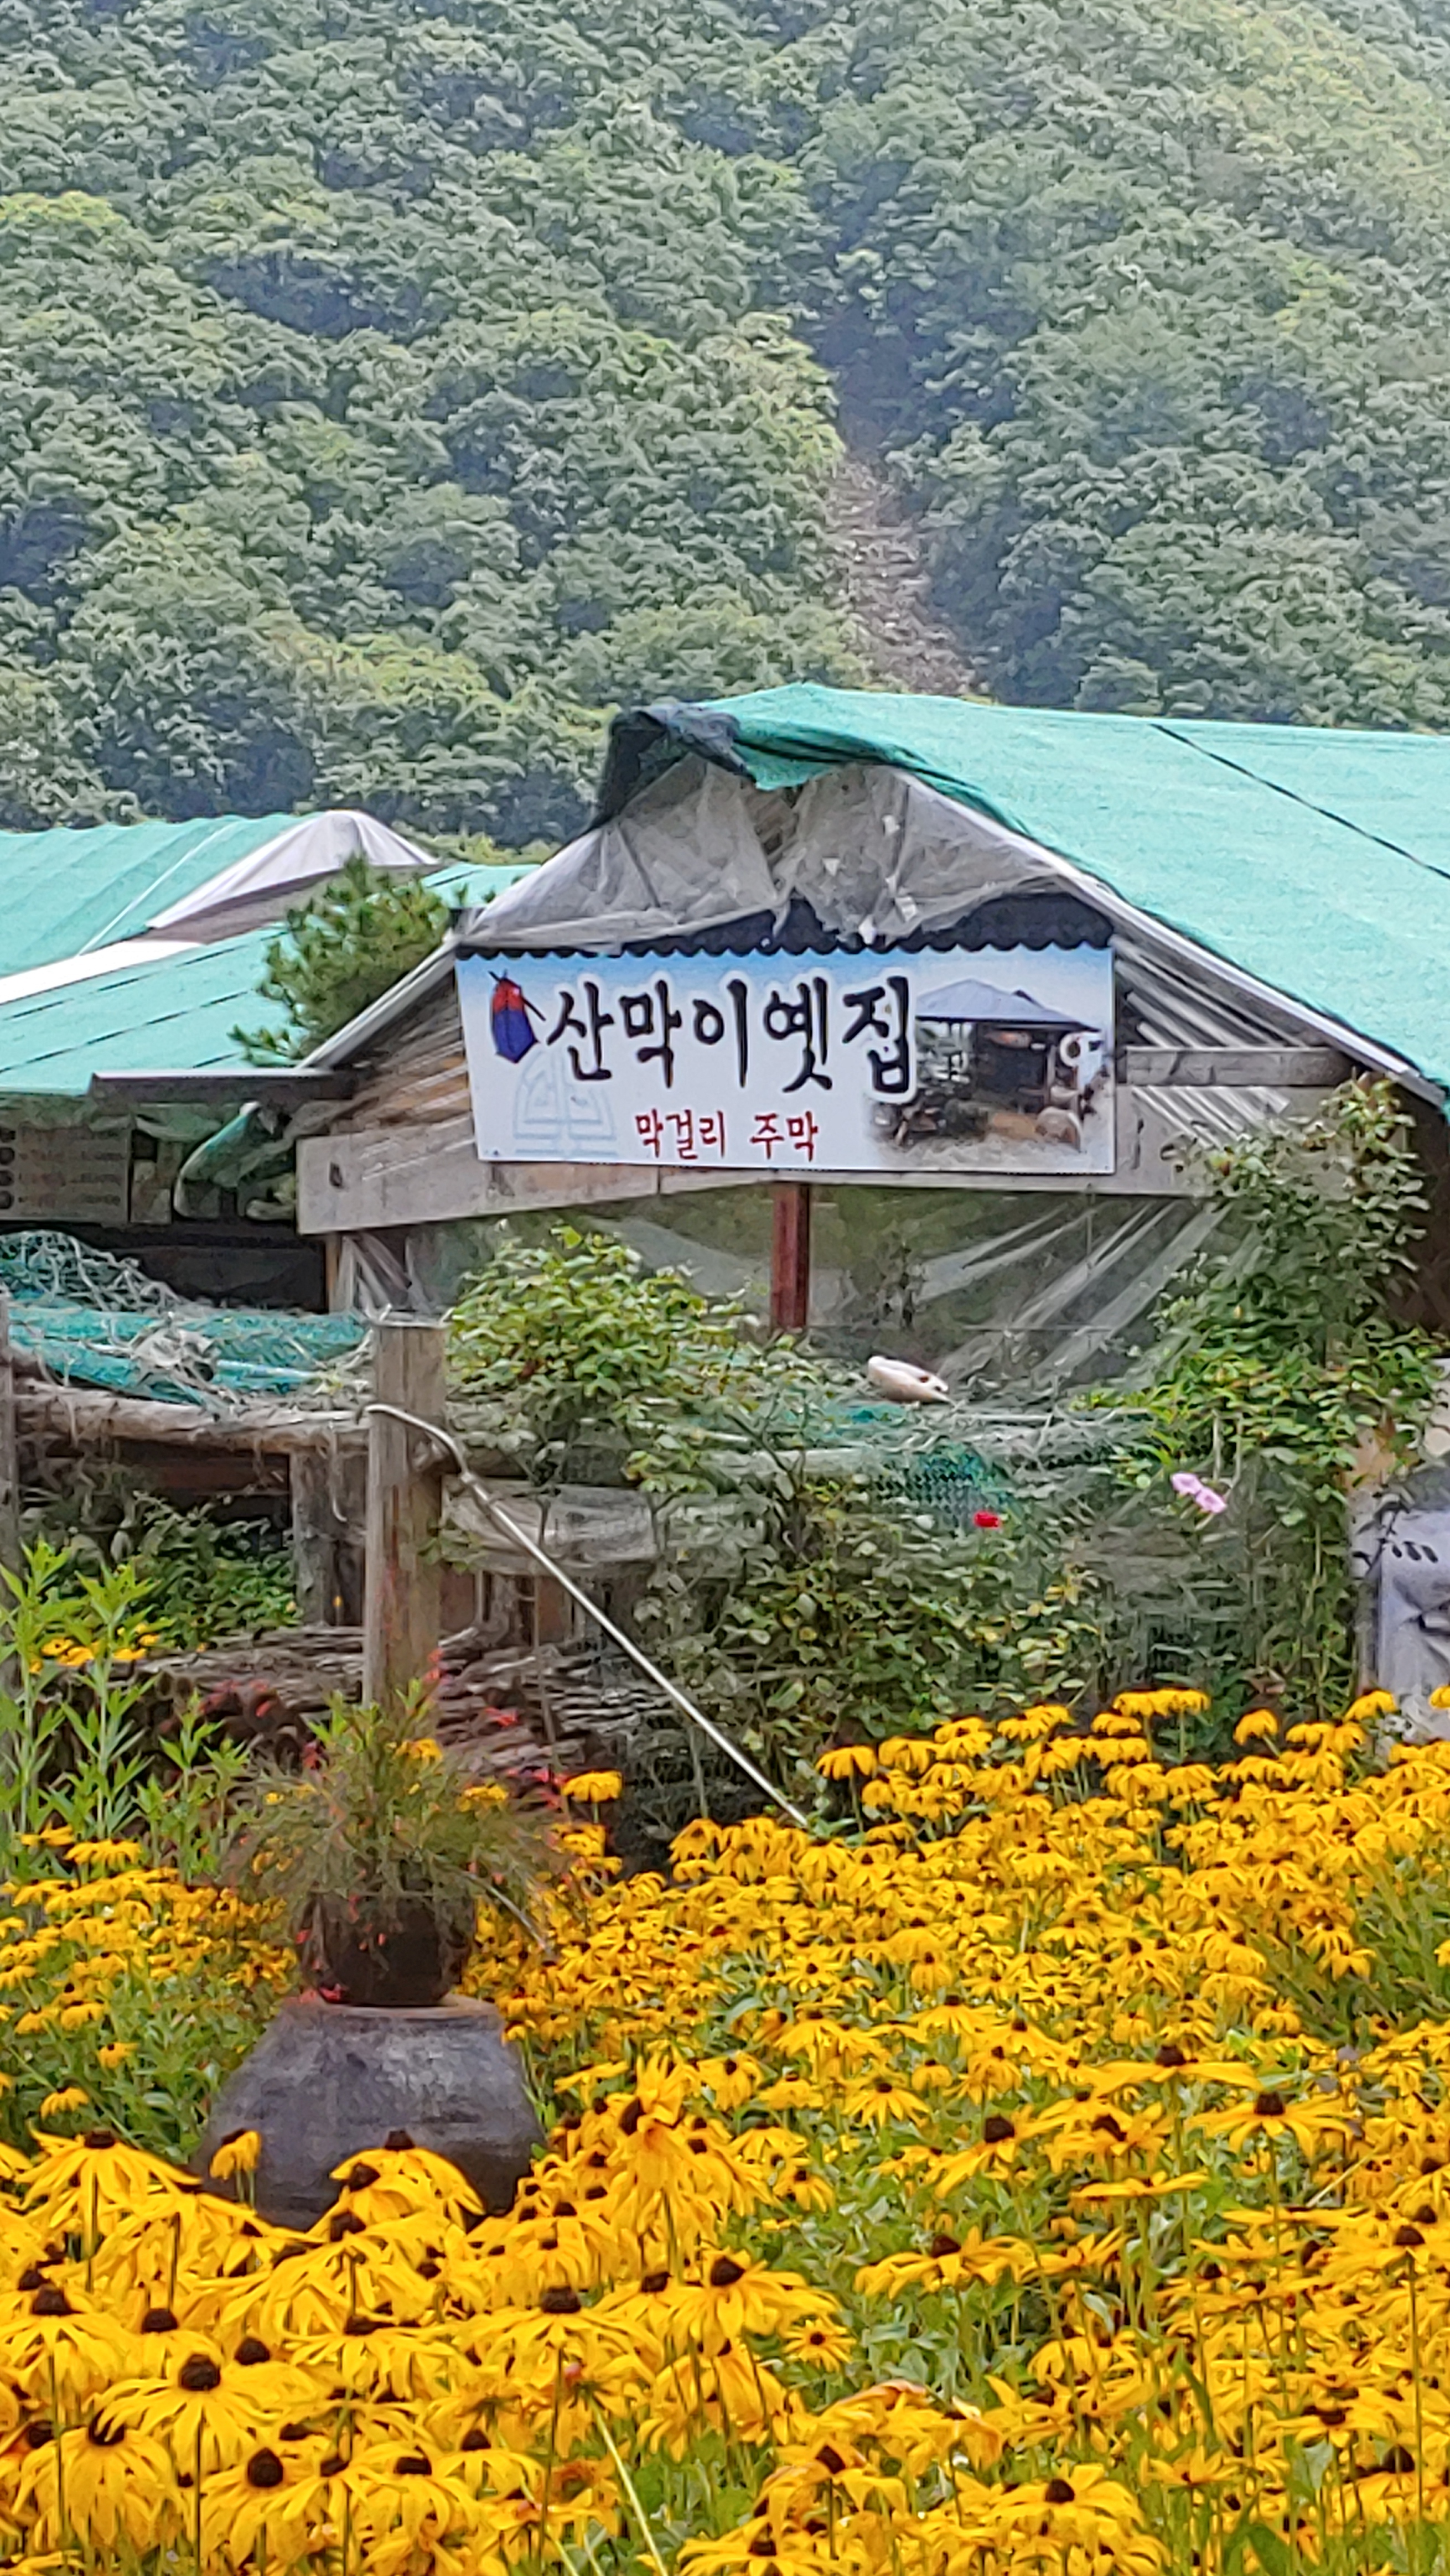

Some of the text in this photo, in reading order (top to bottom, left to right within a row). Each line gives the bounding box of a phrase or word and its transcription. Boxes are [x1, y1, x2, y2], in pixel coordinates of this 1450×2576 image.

[546, 975, 910, 1093] 산막이옛집
[635, 1109, 819, 1162] 막걸리 주막
